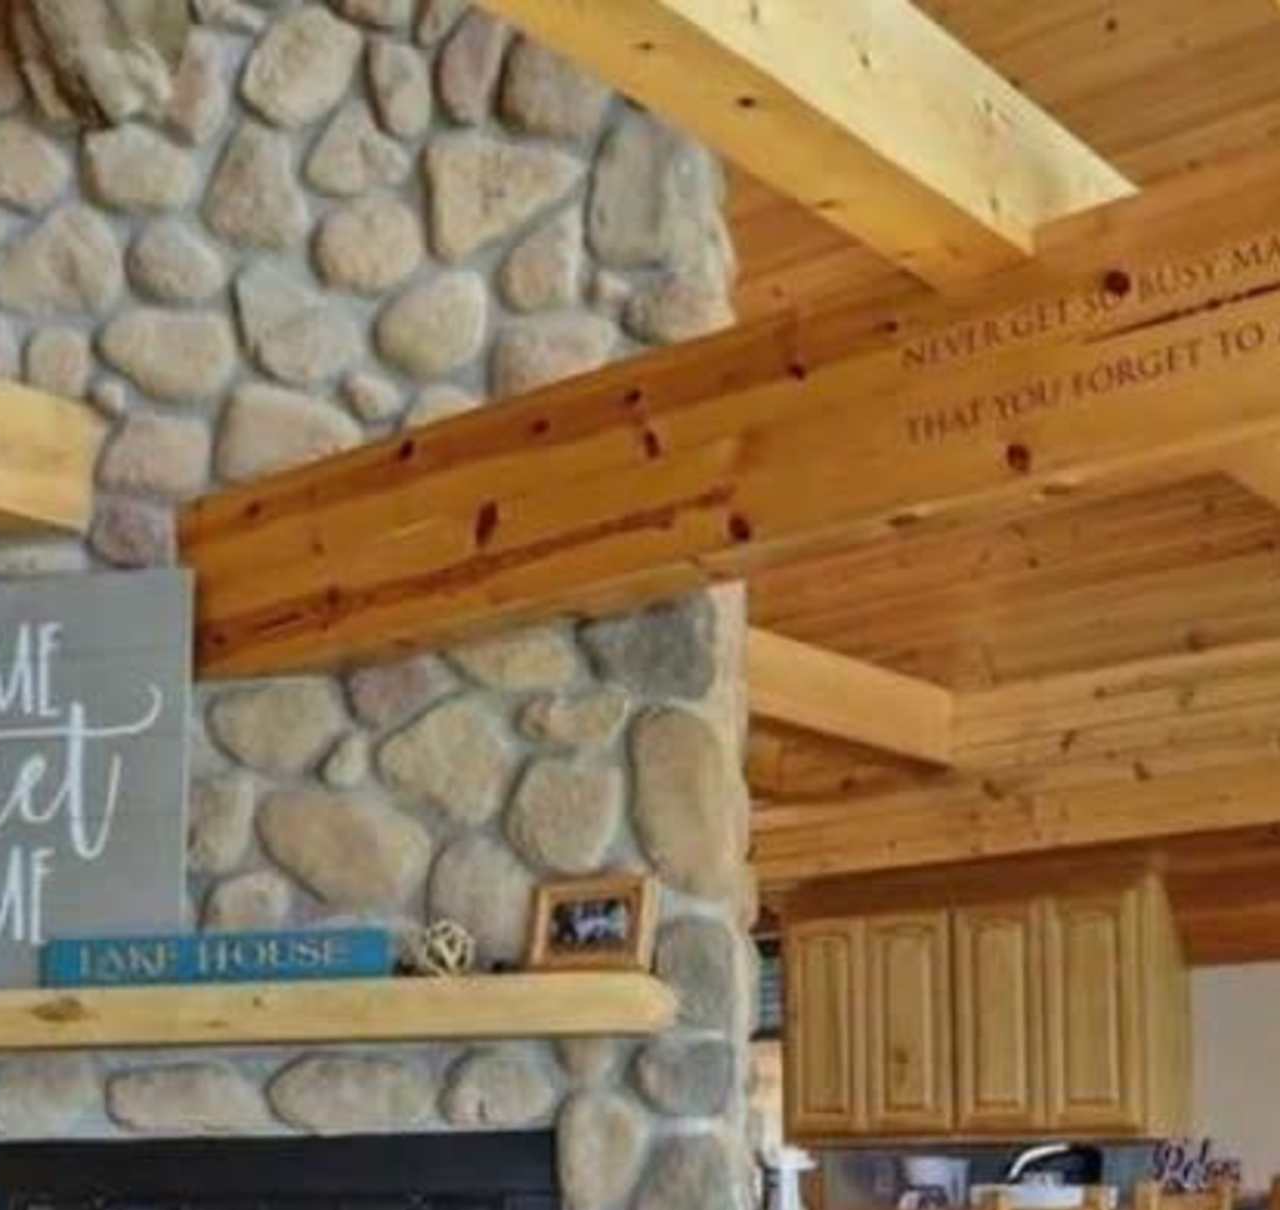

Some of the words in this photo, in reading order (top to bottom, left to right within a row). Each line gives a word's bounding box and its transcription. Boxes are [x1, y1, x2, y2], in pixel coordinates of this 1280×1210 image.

[900, 318, 1001, 369] NEVER
[1009, 297, 1070, 338] GET
[1083, 284, 1122, 323] SO
[1137, 254, 1218, 300] BUSY
[906, 396, 982, 443] THAT
[991, 378, 1062, 420] YOU
[1069, 340, 1204, 398] FORGET
[1215, 319, 1266, 359] TO
[78, 942, 177, 981] LAKE
[195, 934, 354, 977] HOUSE
